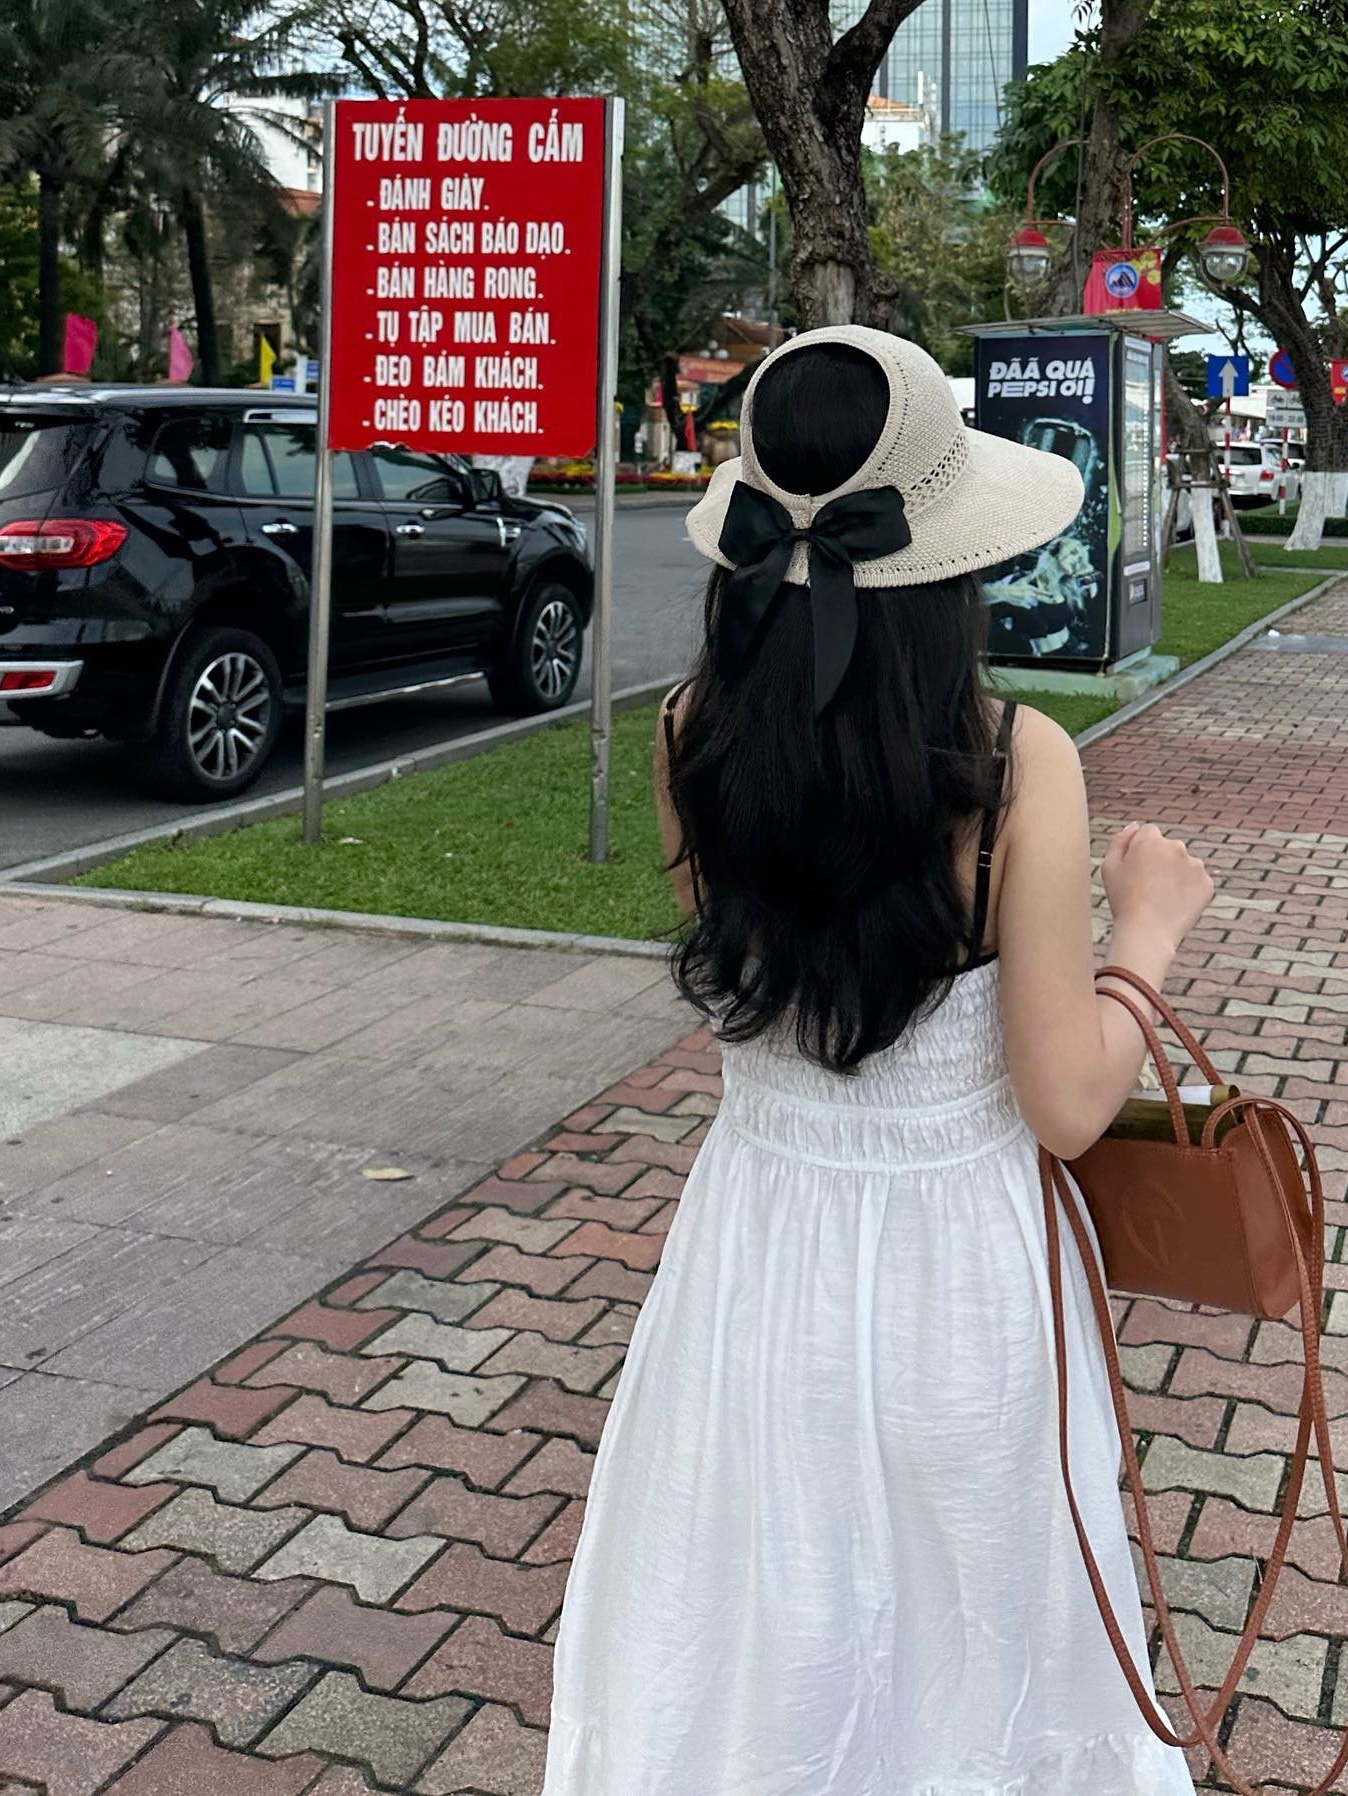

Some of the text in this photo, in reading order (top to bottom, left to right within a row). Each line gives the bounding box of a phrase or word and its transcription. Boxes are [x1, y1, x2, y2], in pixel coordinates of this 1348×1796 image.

[352, 106, 584, 163] TUYẾN ĐƯỜNG CẤM
[379, 173, 431, 210] ĐÁNH
[440, 173, 489, 210] GIÀY.
[378, 216, 416, 254] BÁN
[425, 216, 475, 254] SÁCH
[481, 216, 519, 254] BÁO
[377, 261, 415, 299] BÁN
[423, 259, 475, 299] HÀNG
[484, 266, 544, 299] RONG.
[376, 310, 400, 347] TỤ
[408, 304, 443, 348] TẬP
[453, 311, 497, 344] MUA
[508, 307, 556, 345] BÁN.
[375, 354, 412, 388] ĐEO
[423, 350, 465, 388] BÁM
[474, 350, 544, 390] KHÁCH.
[989, 356, 1095, 380] ĐÃÃ QUÁ
[987, 380, 1057, 398] PEPSI
[428, 394, 466, 433] KÉO
[473, 394, 544, 435] KHÁCH.
